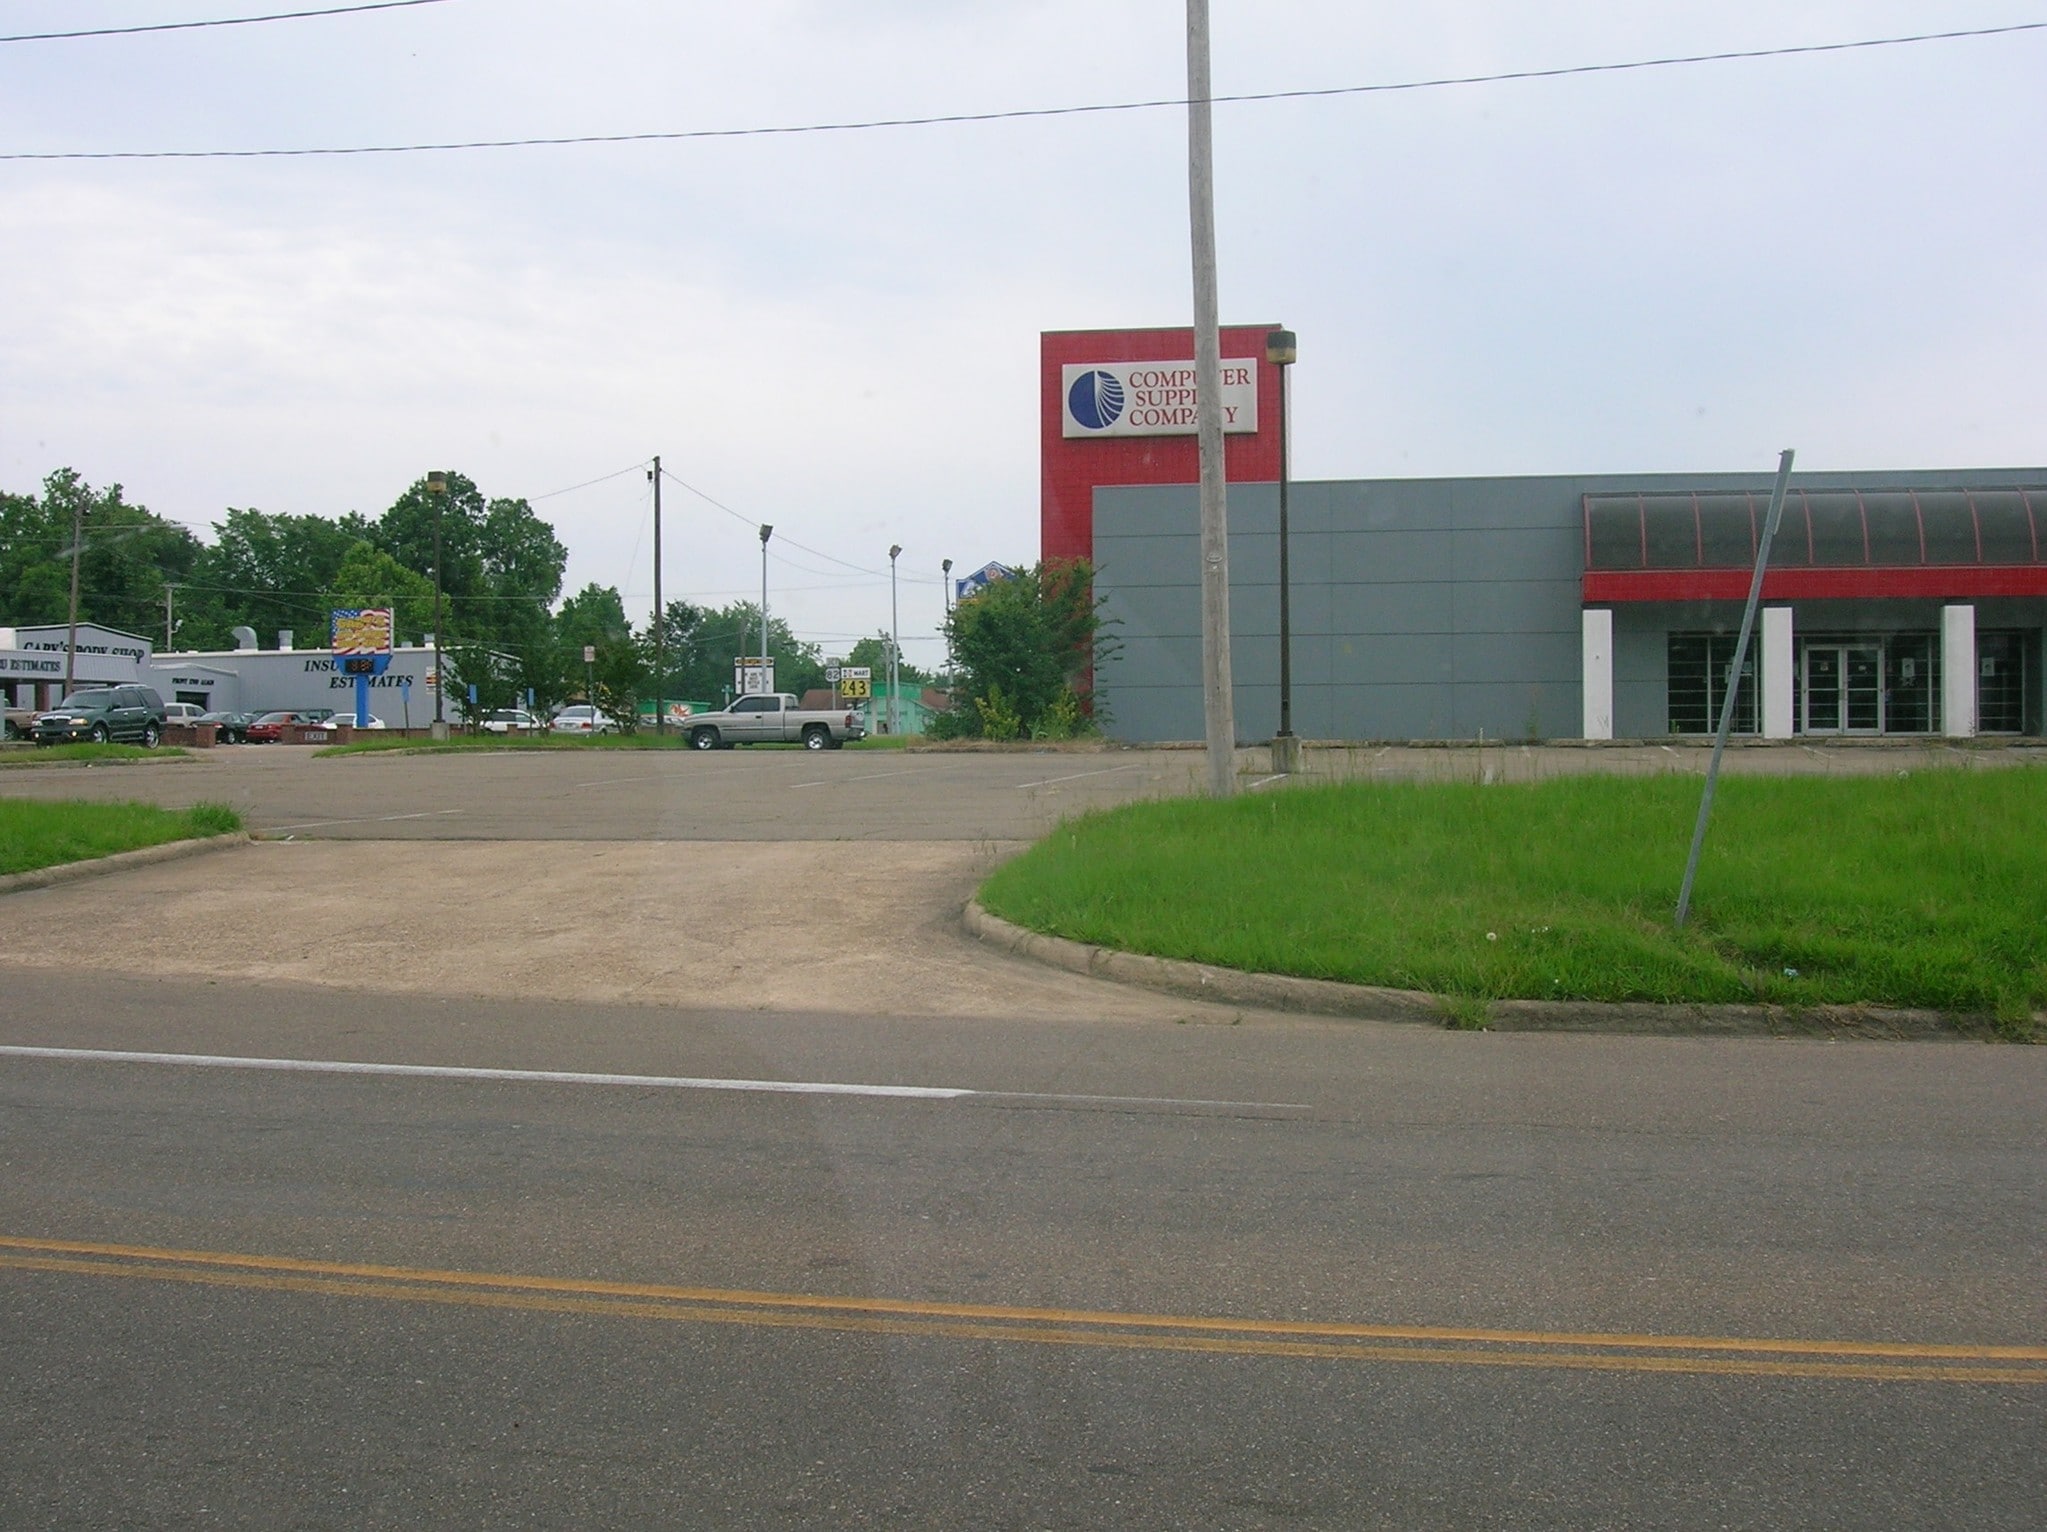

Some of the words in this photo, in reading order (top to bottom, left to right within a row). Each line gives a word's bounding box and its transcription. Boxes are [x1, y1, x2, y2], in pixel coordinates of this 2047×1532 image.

[1129, 368, 1251, 389] COMPER
[329, 675, 414, 689] ESTMATES
[826, 670, 839, 680] 82
